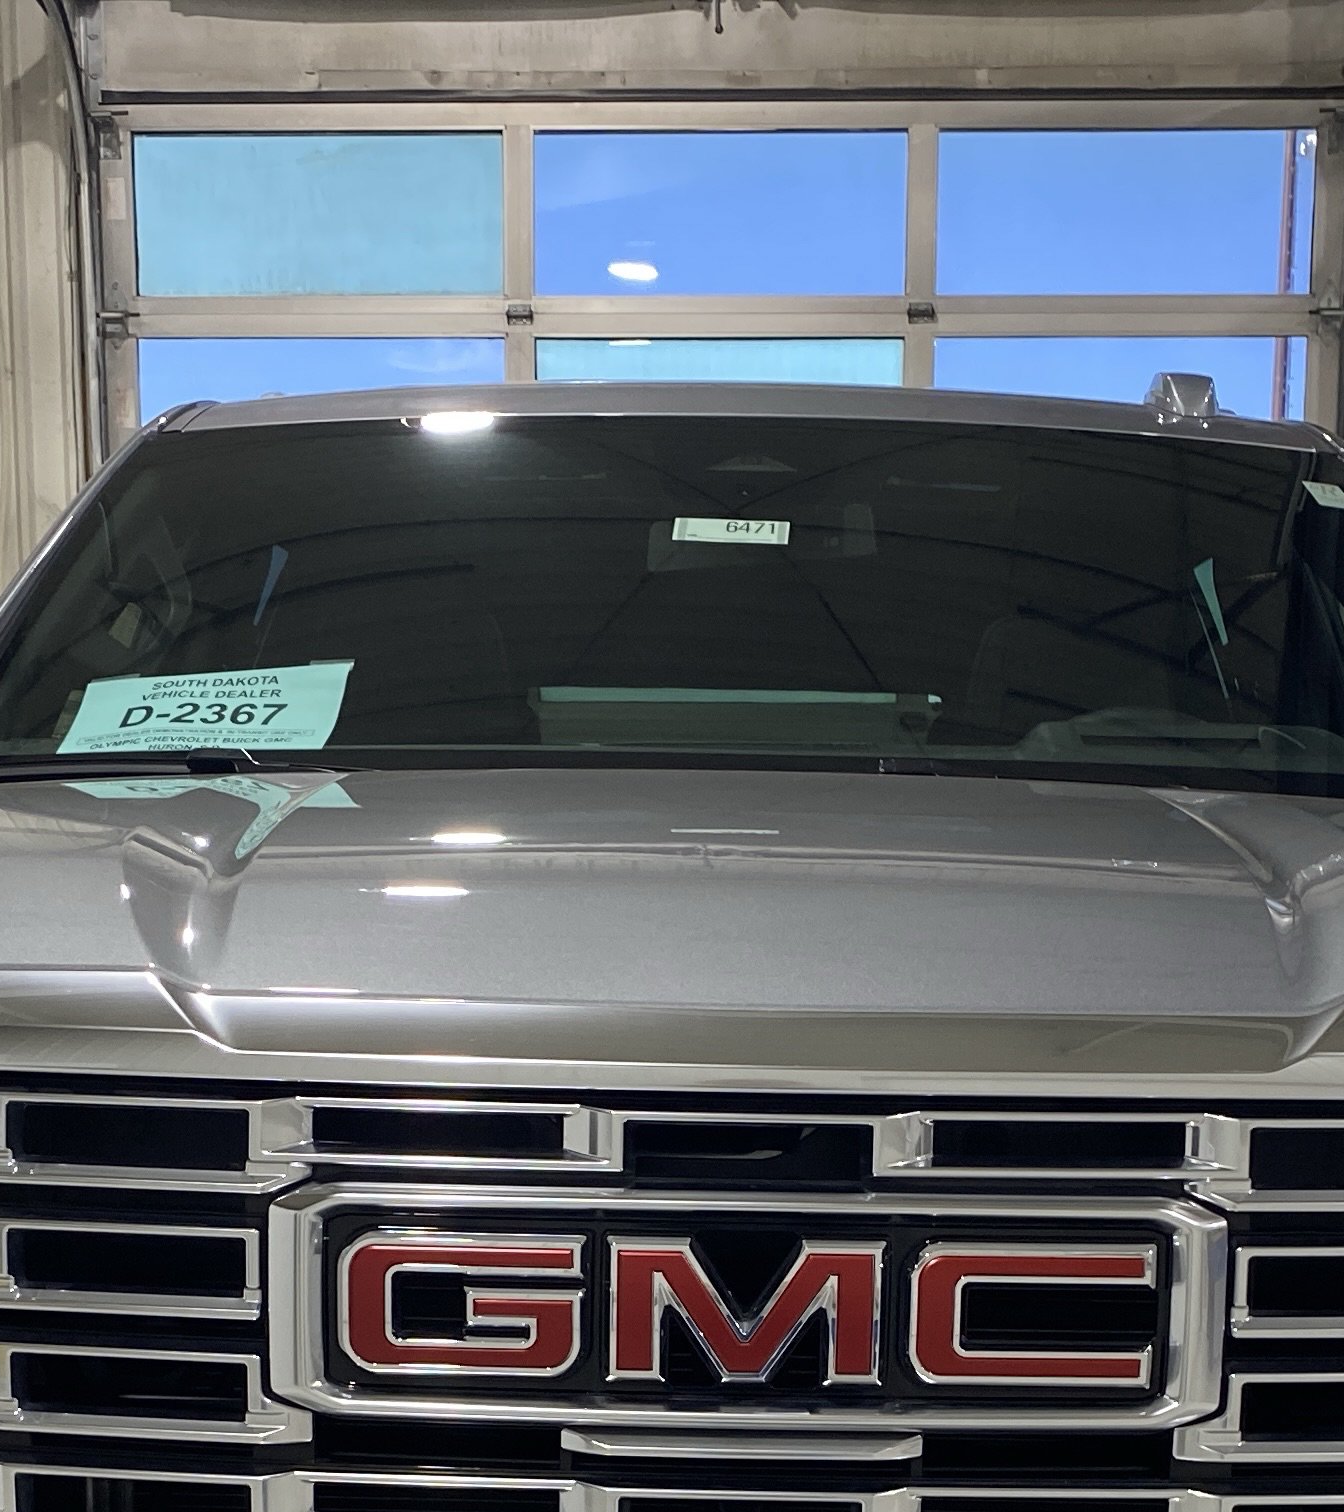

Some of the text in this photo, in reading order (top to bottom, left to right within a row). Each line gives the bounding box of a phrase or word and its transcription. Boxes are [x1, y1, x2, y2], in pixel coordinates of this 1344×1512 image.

[726, 521, 775, 535] 6471
[152, 675, 280, 691] SOUTH DAKOTA
[142, 688, 282, 702] VEHICLE DEALER
[119, 702, 288, 729] D-2367
[89, 737, 142, 750] OLYMPIC
[144, 735, 220, 744] CHEVROLET
[222, 736, 261, 744] BUICK
[338, 1227, 1159, 1388] GMC
